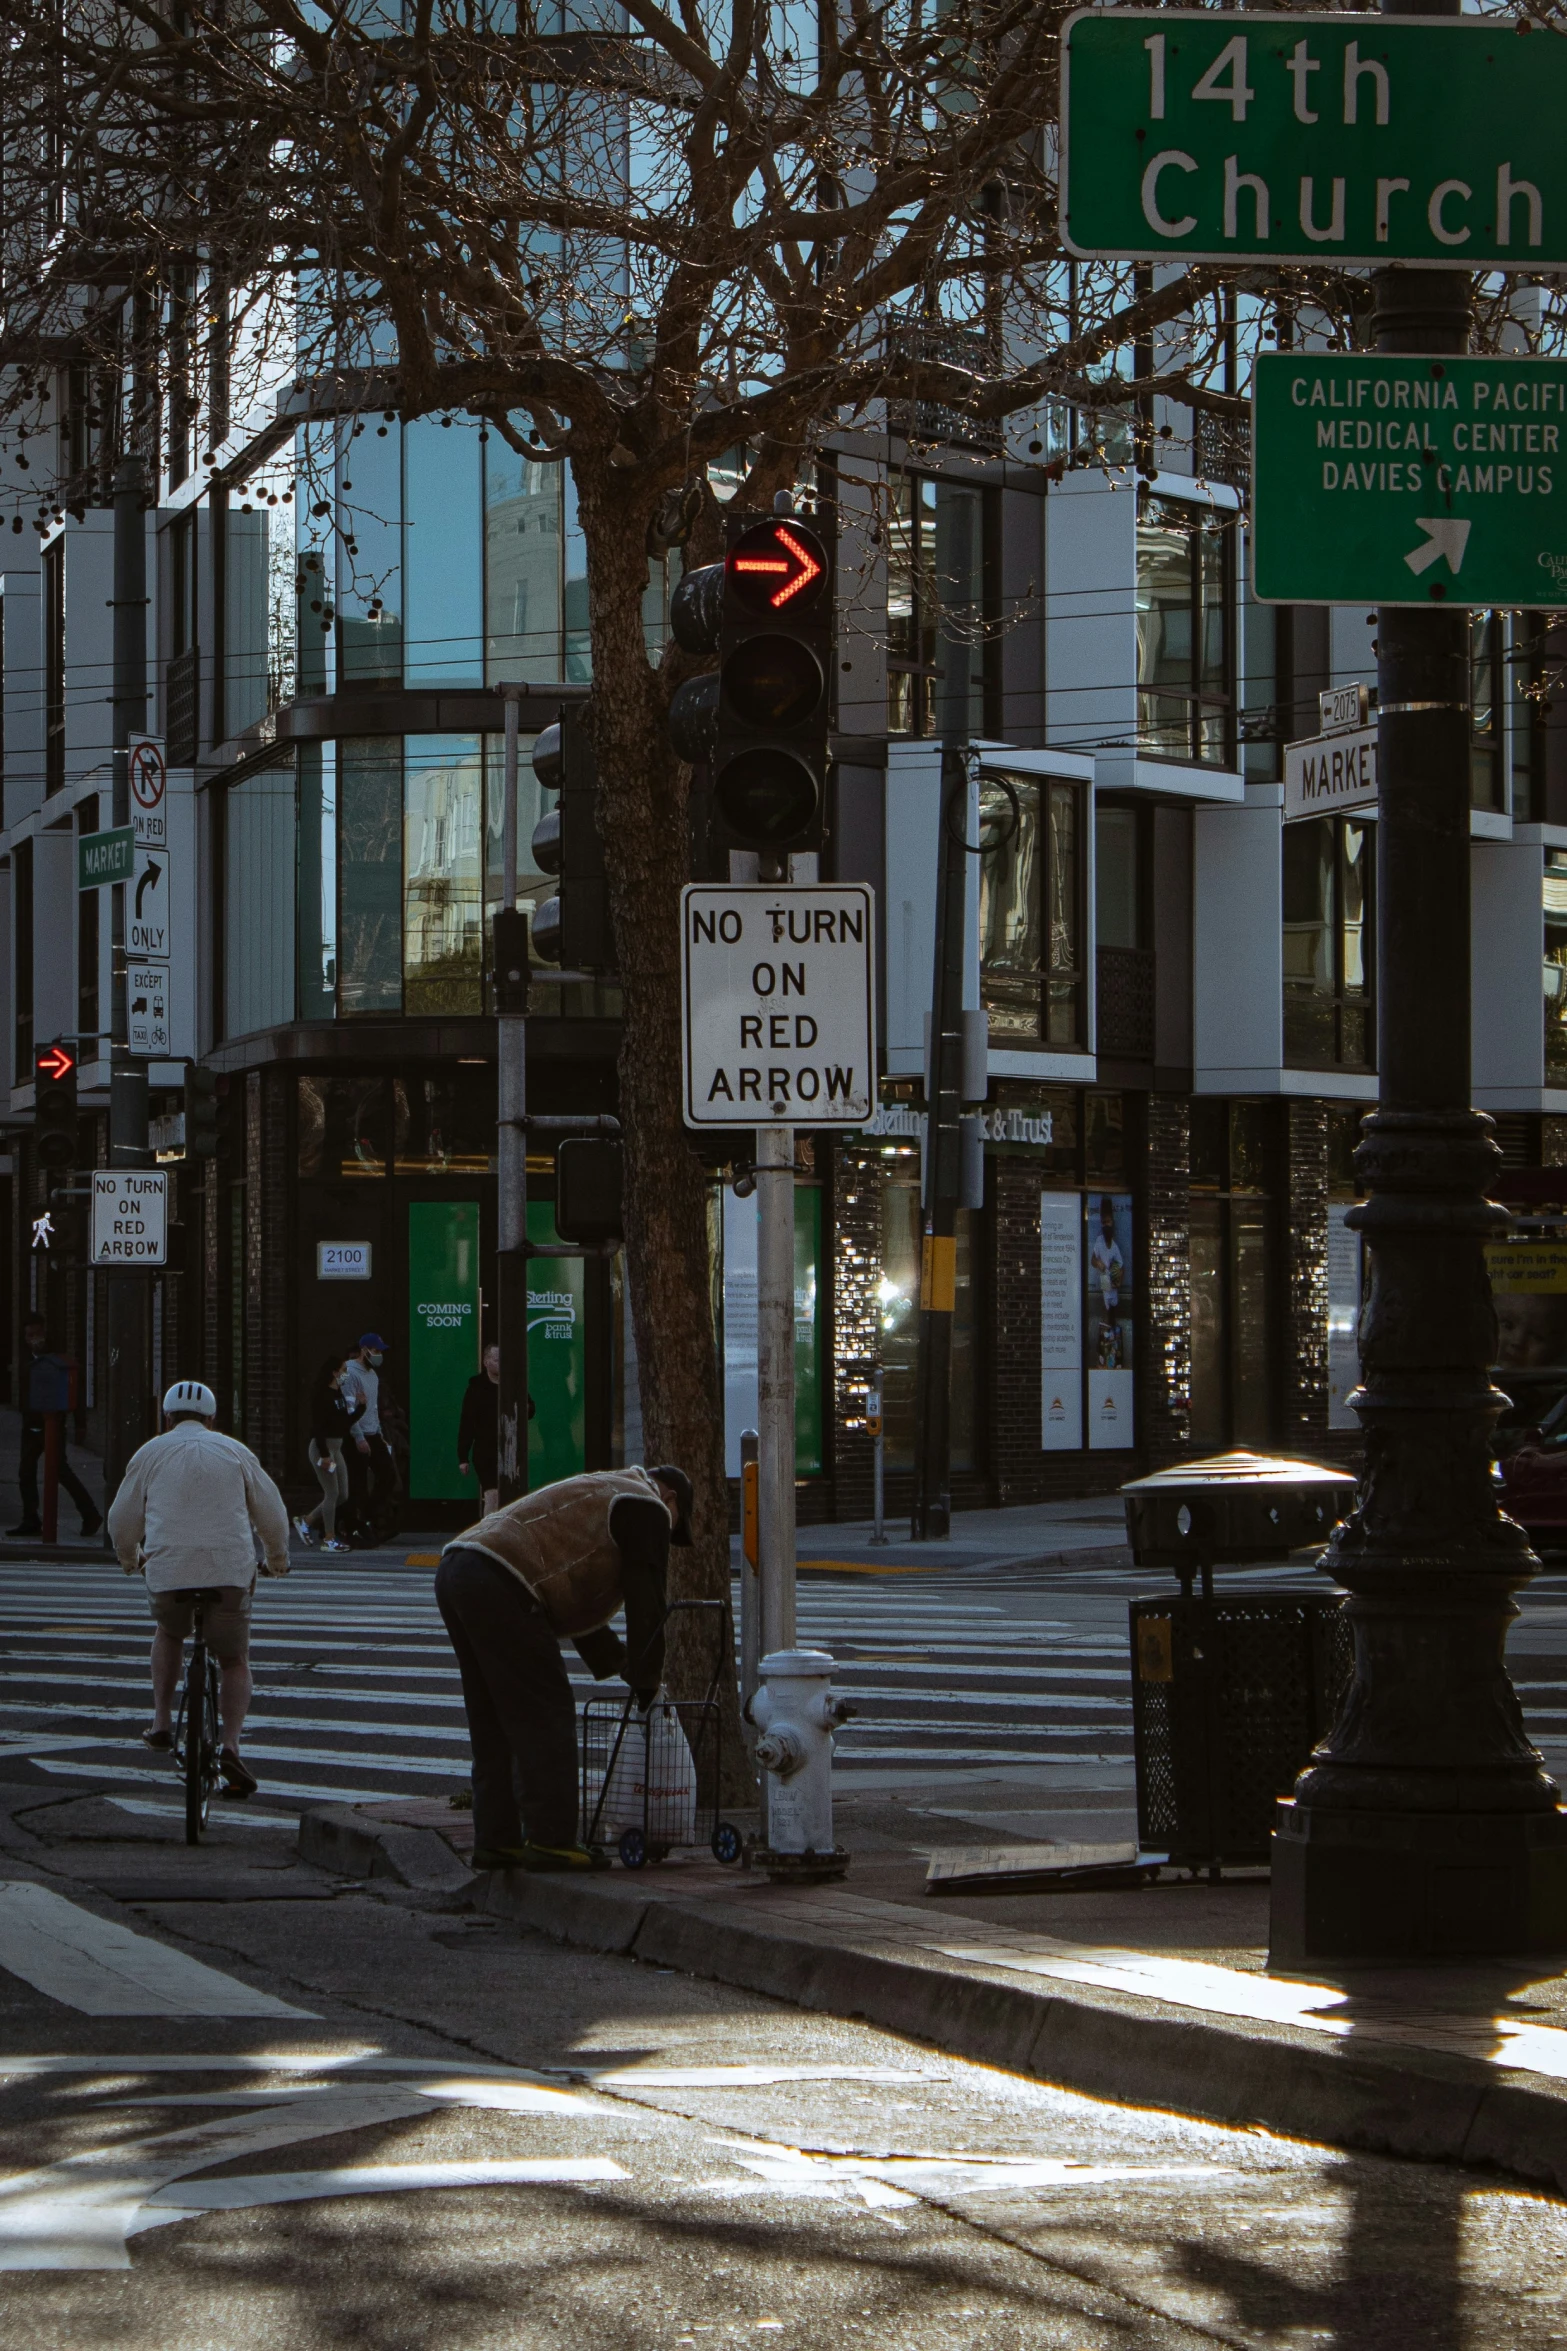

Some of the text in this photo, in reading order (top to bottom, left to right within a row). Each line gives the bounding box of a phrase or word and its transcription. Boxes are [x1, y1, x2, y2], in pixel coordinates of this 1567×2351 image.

[1143, 33, 1390, 125] 14th
[1140, 150, 1543, 247] Church
[1291, 378, 1459, 409] CALIFORNIA
[1316, 420, 1559, 452] MEDICAL CENTER
[1323, 461, 1553, 494] DAVIES CAMPUS
[1333, 689, 1357, 722] 2075
[133, 816, 164, 836] ON RED
[85, 840, 128, 875] MARKET
[692, 909, 863, 944] NO TURN
[131, 926, 165, 949] ONLY
[134, 974, 163, 990] EXCEPT
[752, 962, 805, 996] ON
[133, 1030, 147, 1040] TAXI
[740, 1015, 818, 1049] RED
[707, 1066, 854, 1101] ARROW
[1008, 1108, 1053, 1144] Trust
[96, 1179, 163, 1194] NO TURN
[119, 1200, 140, 1214] ON
[113, 1221, 145, 1234] RED
[101, 1241, 158, 1255] ARROW
[327, 1250, 362, 1263] 2100
[1491, 1256, 1514, 1265] sure
[1507, 1271, 1524, 1280] car
[1527, 1268, 1557, 1280] seat?
[417, 1304, 472, 1314] COMING
[426, 1316, 462, 1327] SOON
[546, 1323, 573, 1331] bank
